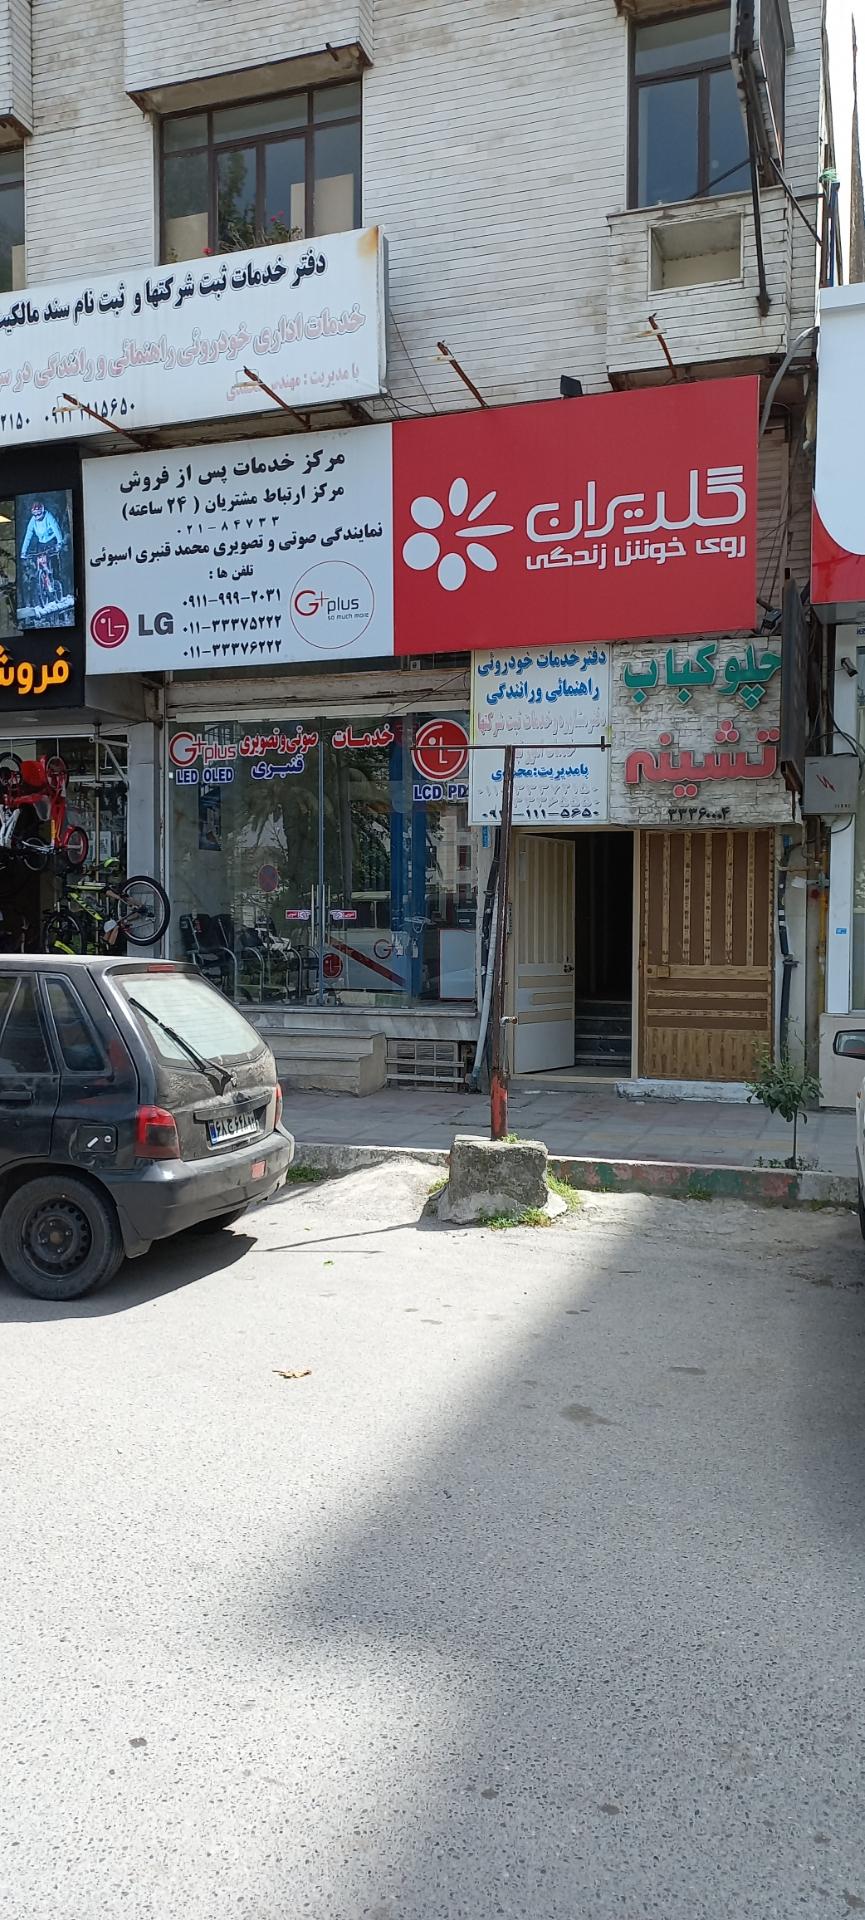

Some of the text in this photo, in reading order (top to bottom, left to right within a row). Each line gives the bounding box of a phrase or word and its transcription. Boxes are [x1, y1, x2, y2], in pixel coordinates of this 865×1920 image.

[0, 249, 326, 333] دفتر خدمات ثبت شرکتها و ثبت نام سند مالکی
[305, 303, 366, 339] خدمات
[253, 312, 303, 355] اداری
[13, 361, 33, 392] در
[34, 347, 95, 388] رانندگی
[95, 355, 107, 380] و
[310, 366, 349, 390] مدیریت
[352, 362, 360, 383] با
[120, 450, 345, 492] مرکز خدمات پس از فروش
[205, 491, 258, 513] مشتریان
[263, 485, 305, 505] ارتباط
[311, 482, 344, 503] مرکز
[213, 534, 263, 556] تصویری
[267, 539, 275, 552] و
[279, 531, 317, 550] صوتی
[320, 522, 383, 547] نمایندگی
[136, 542, 171, 563] قنبری
[175, 543, 209, 556] محمد
[526, 536, 746, 570] روی خوش زندگی
[232, 565, 254, 581] تلفن
[182, 588, 281, 608] ۰۹۱۱-۹۹۹-۲۰۳۱
[138, 612, 174, 637] LG
[183, 615, 281, 634] ۰۱۱-۳۳۳۷۵۲۲۲
[183, 639, 282, 658] ۰۱۱-۳۳۳۷۶۲۲۲
[537, 649, 580, 668] خدمات
[580, 647, 608, 671] دفتر
[332, 723, 394, 749] خدمات
[176, 767, 234, 785] LED OLED
[251, 754, 304, 779] قنبری
[413, 784, 443, 801] LCD
[447, 783, 469, 800] PD
